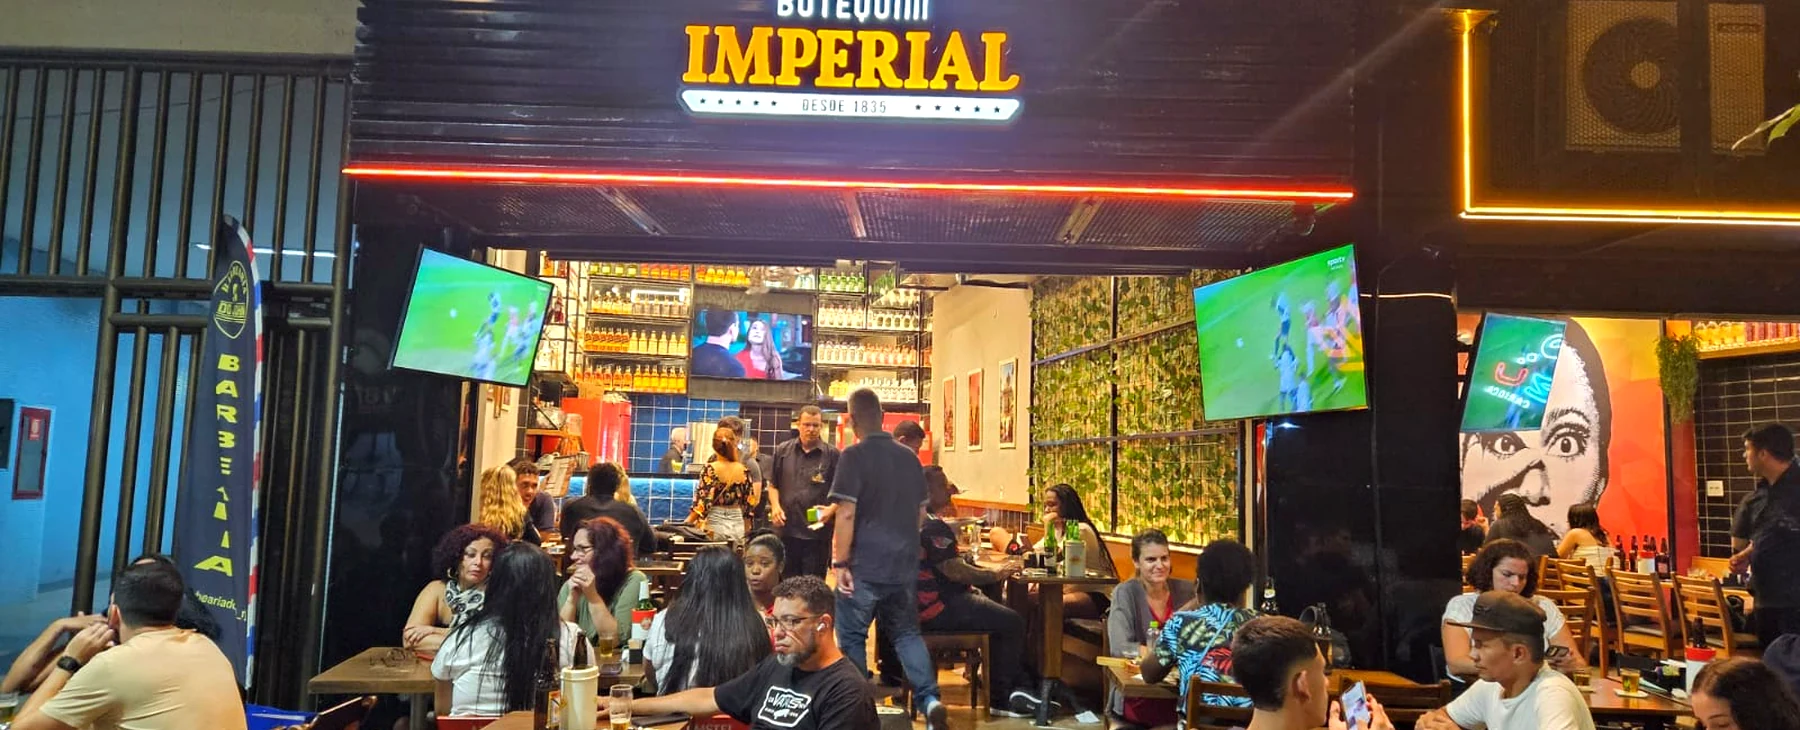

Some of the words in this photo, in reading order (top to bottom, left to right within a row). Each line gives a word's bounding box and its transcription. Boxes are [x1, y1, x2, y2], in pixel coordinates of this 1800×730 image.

[682, 26, 1020, 91] IMPERIAL
[802, 98, 845, 113] DESDE
[854, 100, 887, 114] 1835
